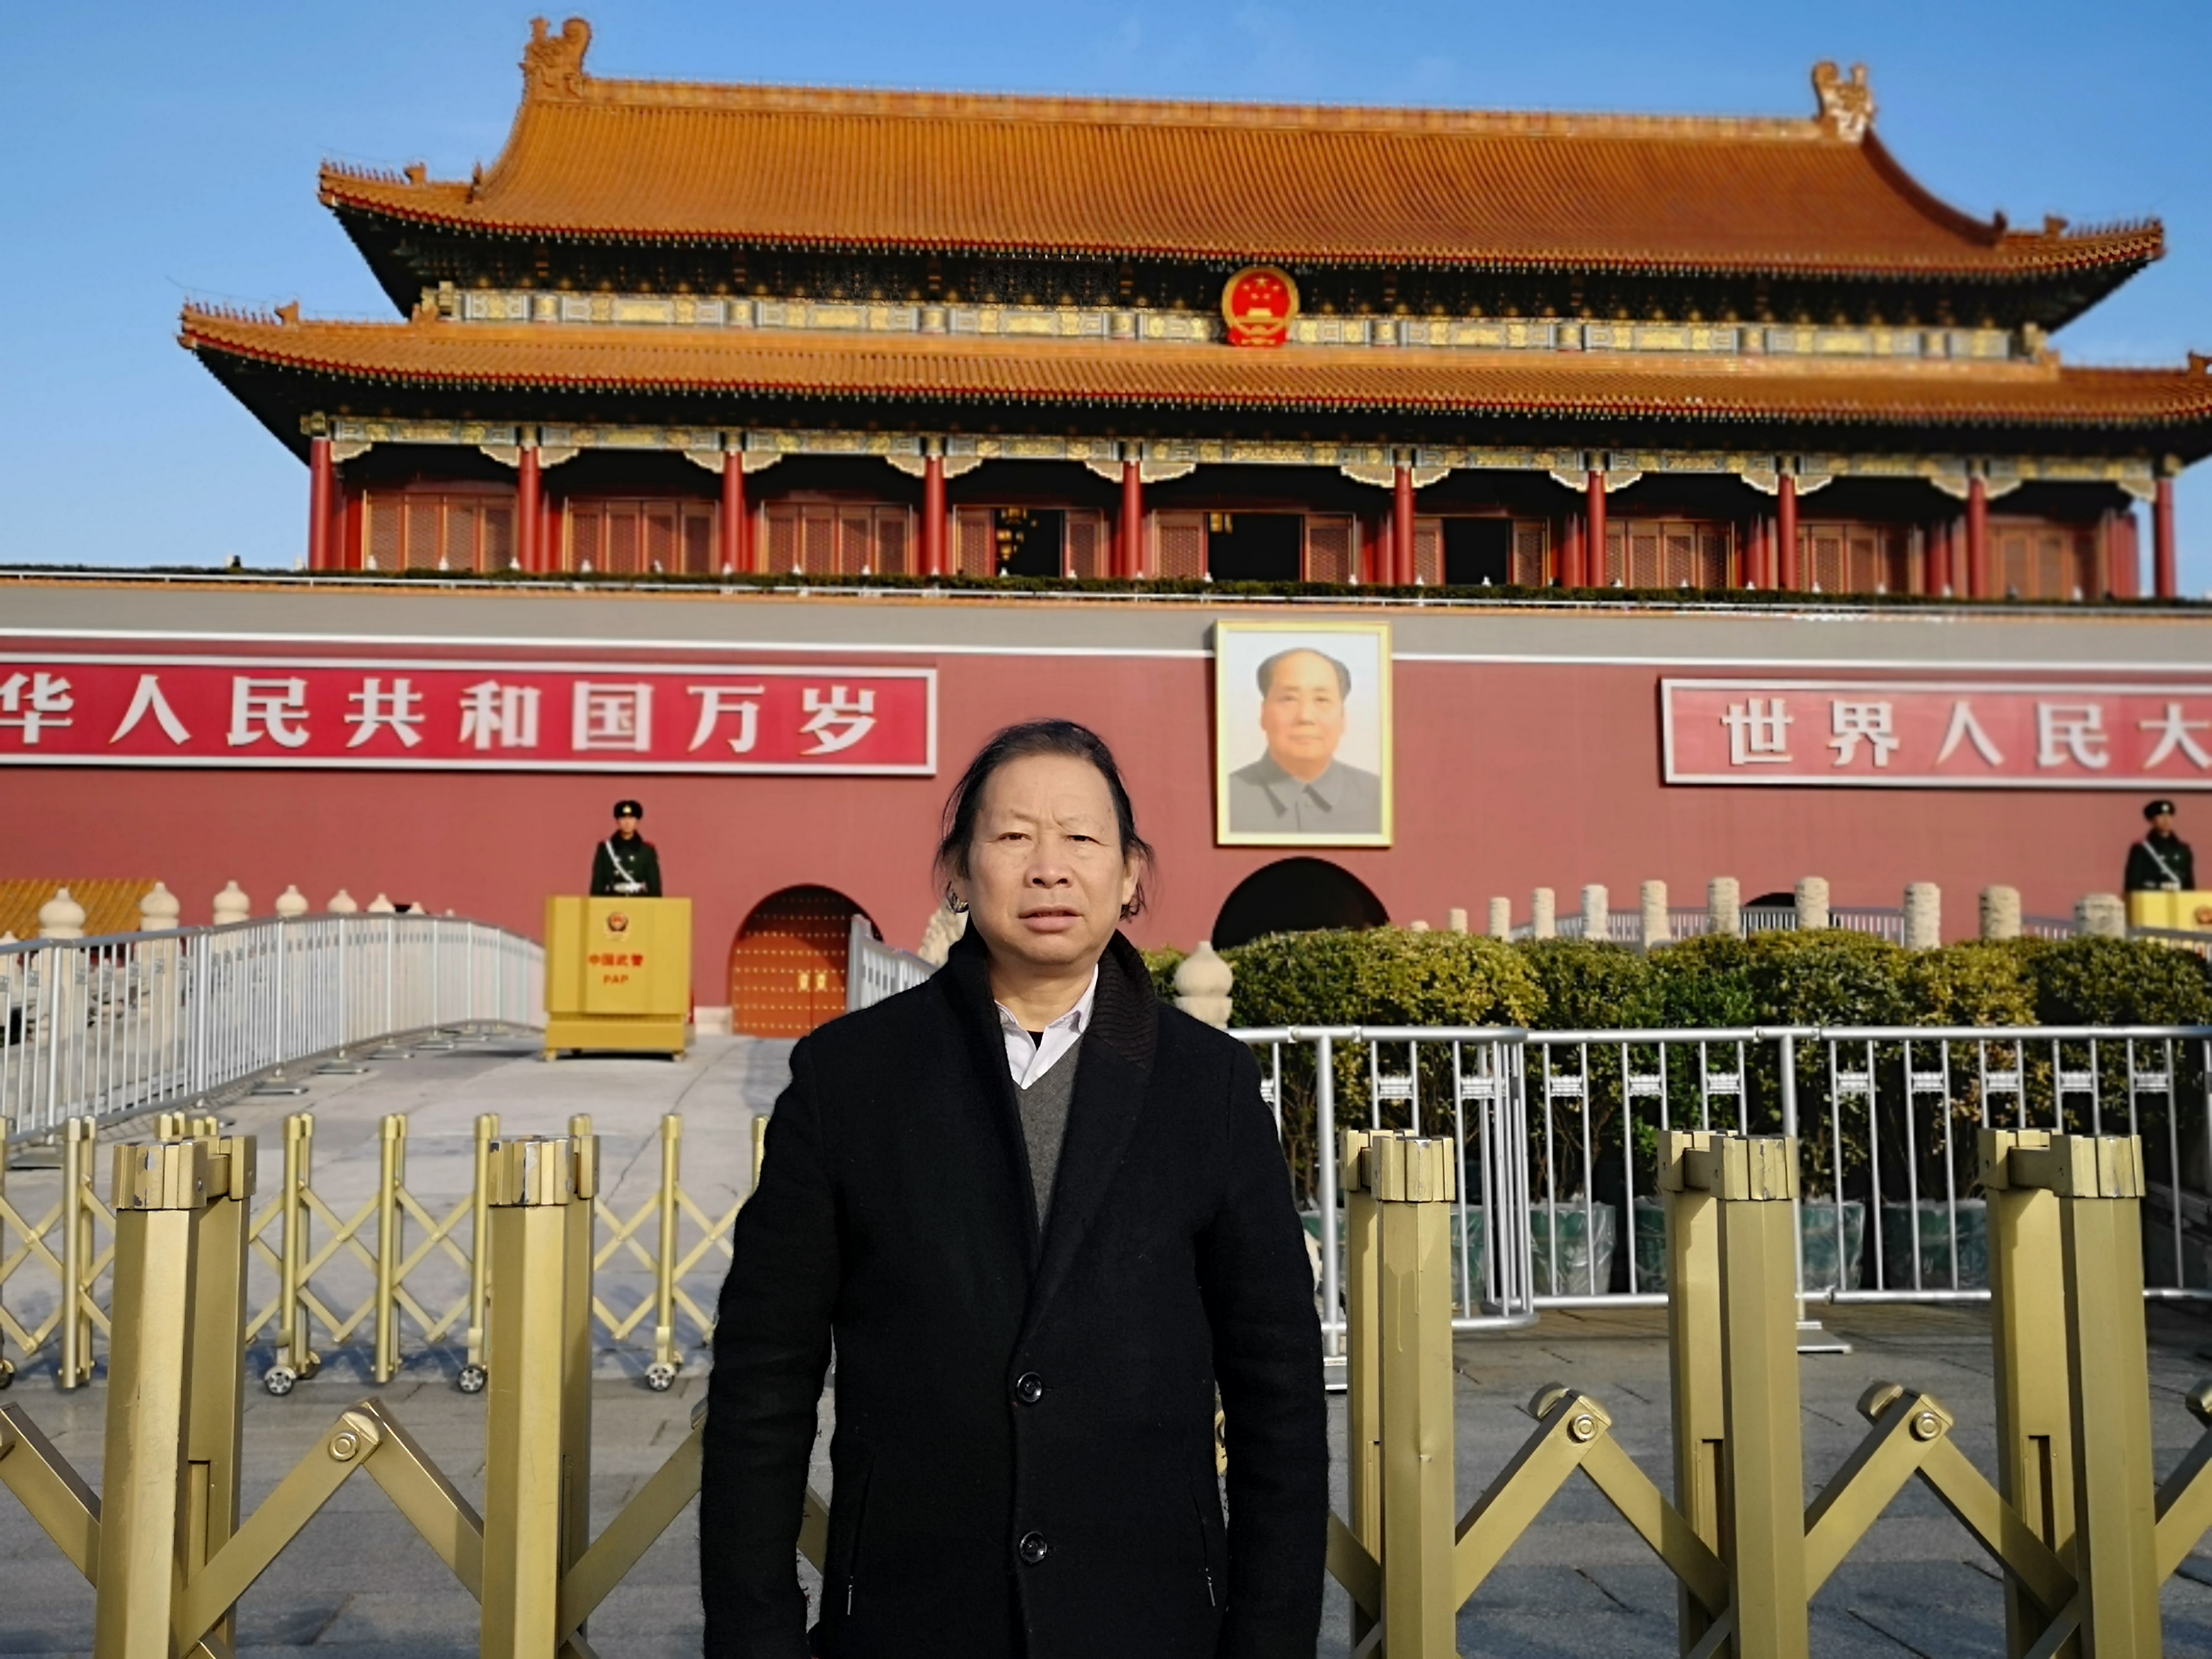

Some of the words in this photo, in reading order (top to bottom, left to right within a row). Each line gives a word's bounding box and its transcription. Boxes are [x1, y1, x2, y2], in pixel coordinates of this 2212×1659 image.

[0, 672, 877, 756] 华人民共和国万岁
[1720, 697, 2212, 769] 世界人民大
[603, 974, 629, 984] PAP
